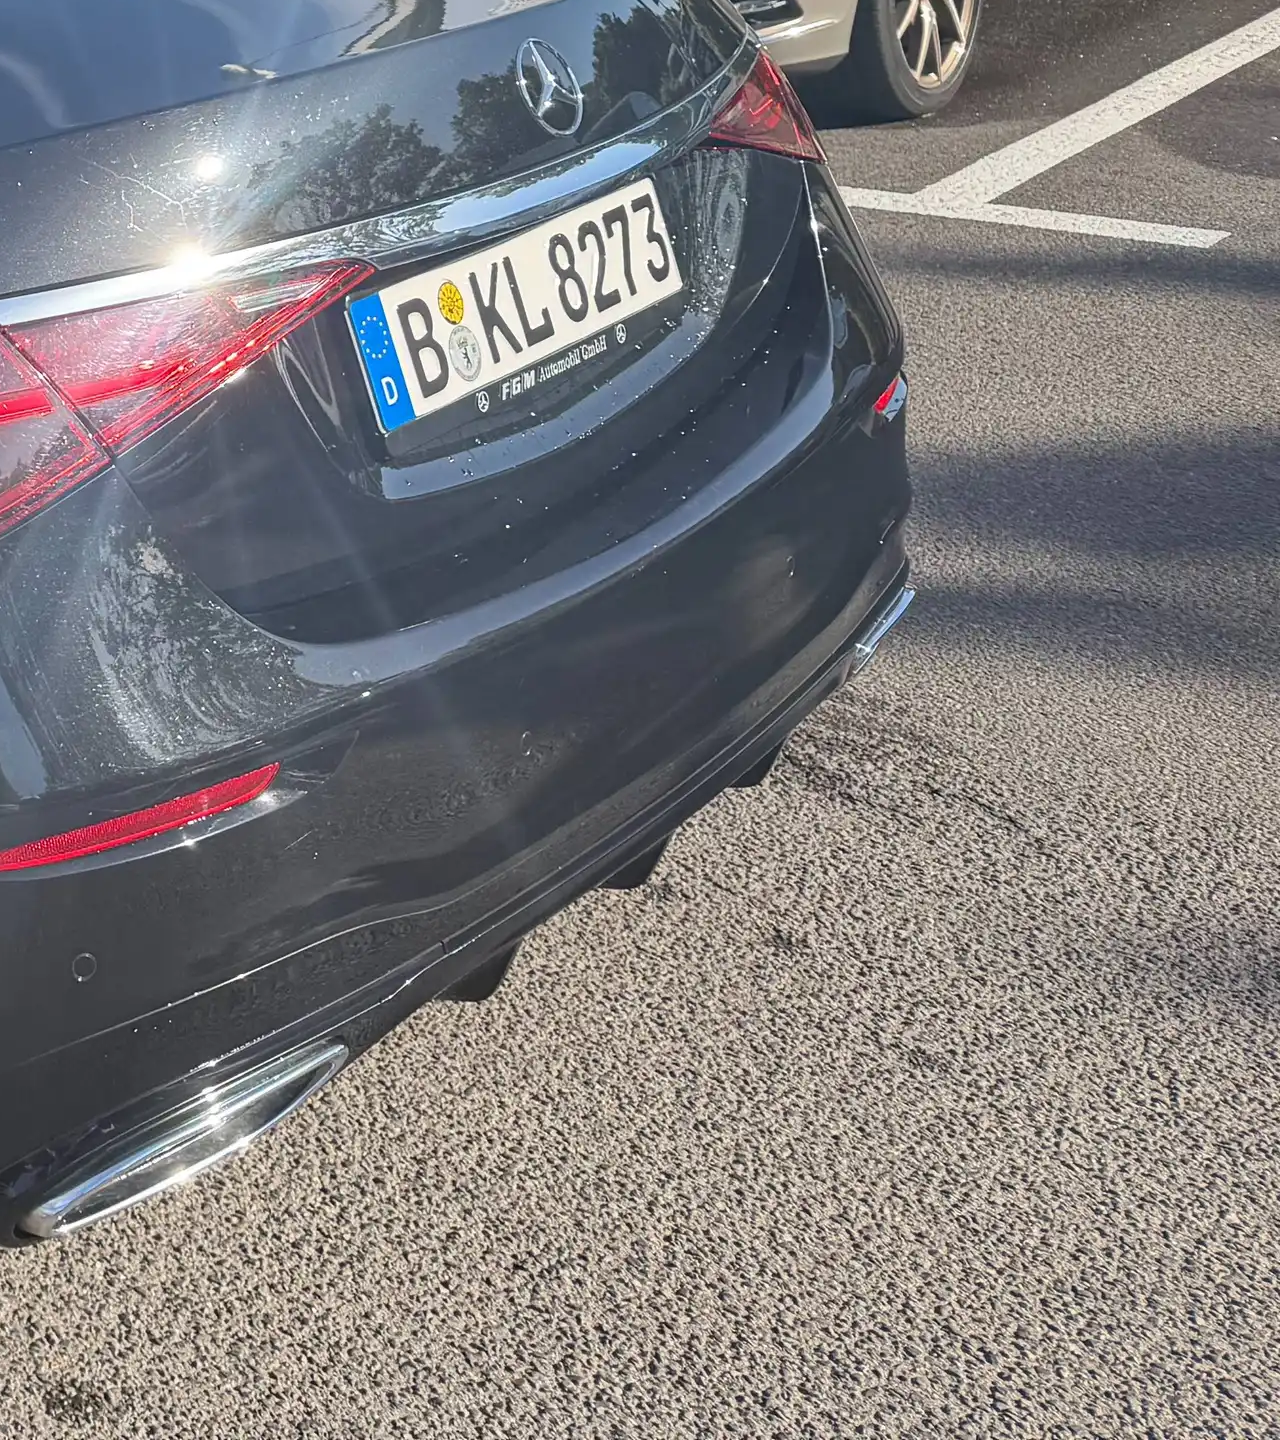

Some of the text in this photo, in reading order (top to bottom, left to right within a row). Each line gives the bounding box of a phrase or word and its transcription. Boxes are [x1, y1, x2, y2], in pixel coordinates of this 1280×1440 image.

[396, 297, 450, 399] B
[468, 256, 555, 364] KL
[548, 193, 672, 323] 8273
[538, 348, 581, 383] Automobil
[580, 335, 608, 360] GmbH
[381, 376, 398, 406] D
